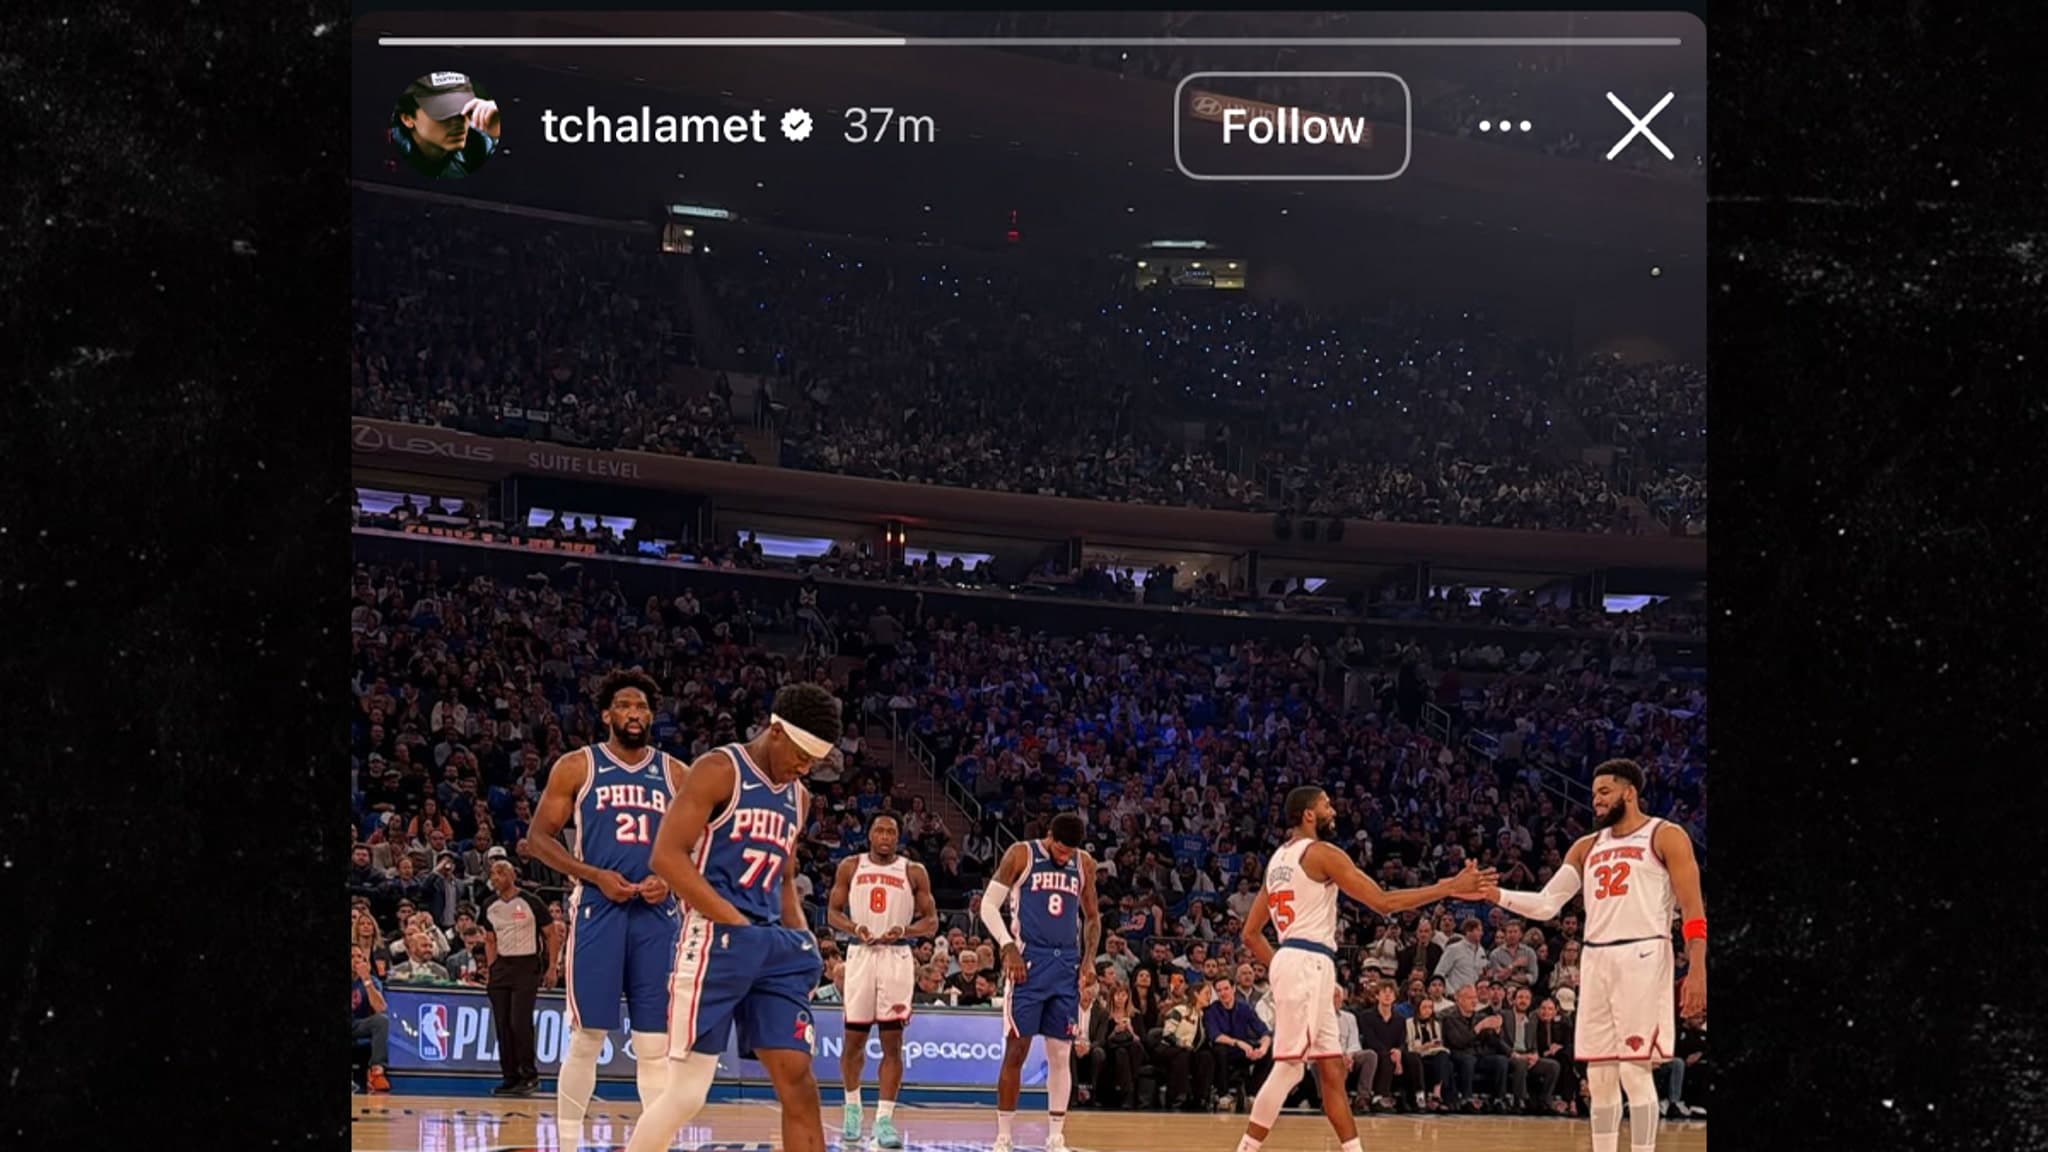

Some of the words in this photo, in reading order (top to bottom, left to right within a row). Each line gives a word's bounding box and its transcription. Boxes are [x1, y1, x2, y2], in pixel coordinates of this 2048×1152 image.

[388, 436, 494, 462] LEXUS
[528, 452, 581, 473] SUITE
[588, 458, 641, 479] LEVEL
[595, 785, 667, 813] PHILA
[615, 812, 650, 845] 21
[738, 848, 783, 891] 77
[1593, 861, 1630, 900] 32
[1031, 871, 1079, 896] PHILA
[869, 887, 887, 914] 8
[1048, 893, 1063, 916] 8
[821, 1036, 885, 1059] NC
